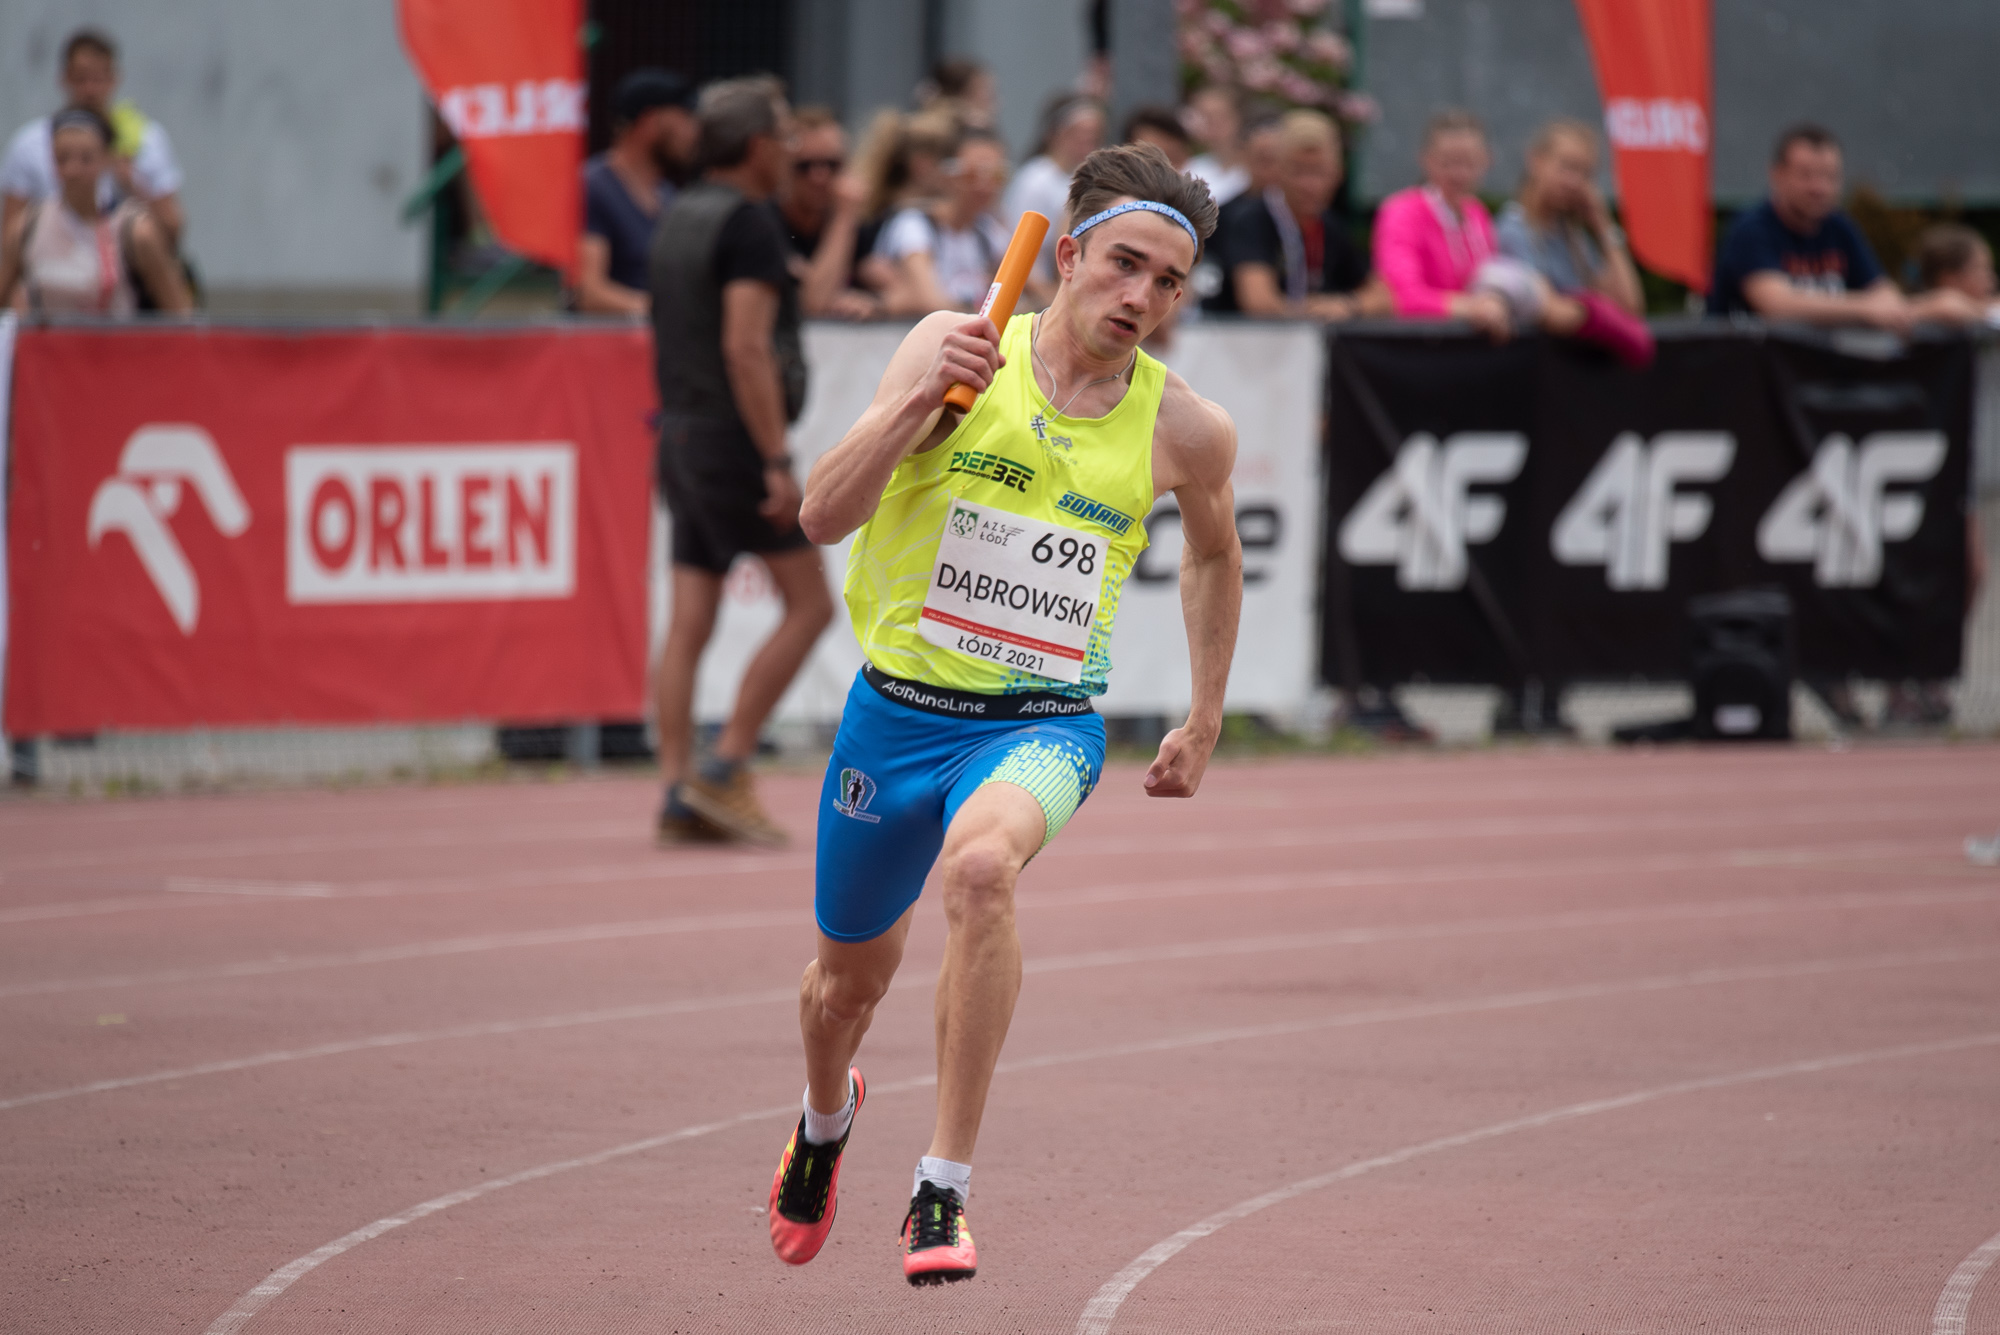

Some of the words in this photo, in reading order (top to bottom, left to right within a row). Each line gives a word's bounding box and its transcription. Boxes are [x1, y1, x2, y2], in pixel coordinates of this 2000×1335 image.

[308, 468, 553, 579] ORLEN
[1057, 492, 1134, 536] SONAROL
[1336, 430, 1530, 592] 4F
[1550, 430, 1738, 592] 4F
[1755, 430, 1949, 591] 4F
[1031, 532, 1097, 576] 698
[936, 562, 1095, 628] DĄBROWSKI
[957, 635, 1003, 660] ŁÓDŹ
[1005, 649, 1044, 672] 2021
[882, 680, 986, 714] AdRunaLine
